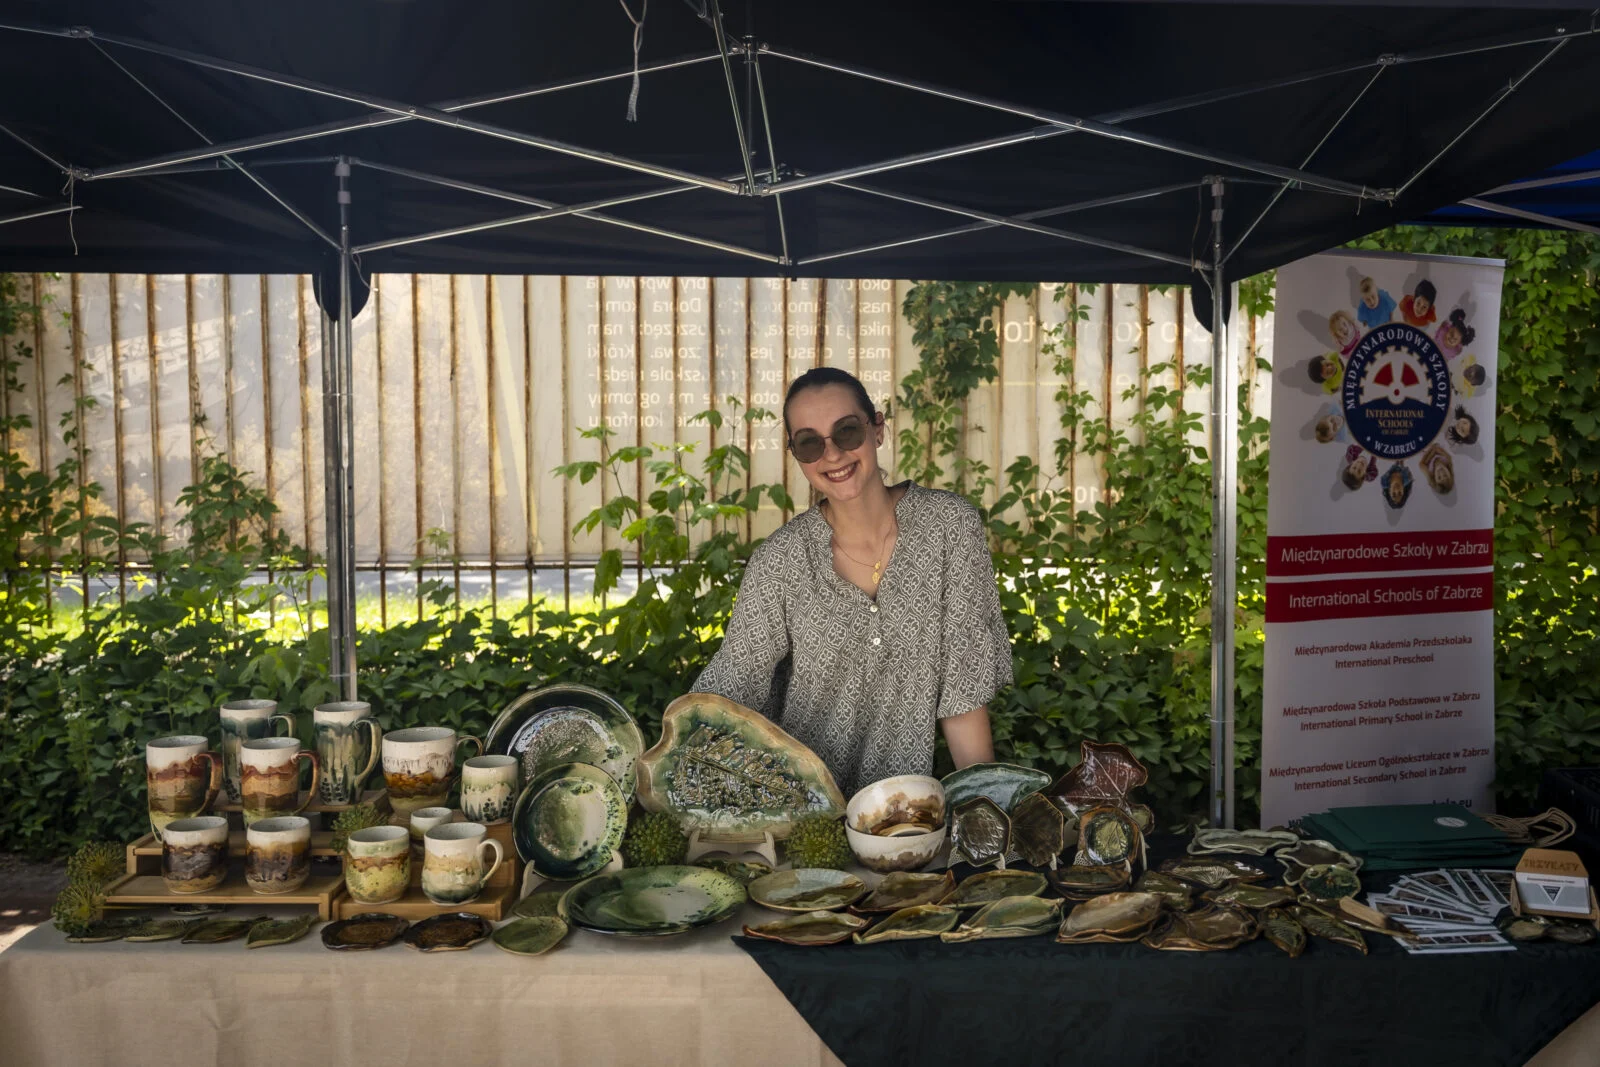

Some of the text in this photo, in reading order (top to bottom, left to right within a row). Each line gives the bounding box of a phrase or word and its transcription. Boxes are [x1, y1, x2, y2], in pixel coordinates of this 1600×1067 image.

[1346, 328, 1430, 410] MIĘDZYNARODOWE
[1365, 408, 1425, 419] INTERNATIONAL
[1377, 419, 1414, 428] SCHOOLS
[1374, 440, 1417, 454] W ZABRZU
[1281, 541, 1489, 565] Międzynarodowe Szkoły w Zabrzu
[1289, 584, 1483, 609] International Schools of Zabrze
[1294, 635, 1472, 657] Międzynarodowa Akademia Przedszkolaka
[1335, 653, 1434, 669] International Preschool
[1282, 691, 1481, 718] Międzynarodowa Szkoła Podstawowa w Zabrzu
[1300, 708, 1463, 732] International Primary School in Zabrze
[1269, 761, 1344, 778] Międzynarodowe
[1345, 757, 1377, 770] Liceum
[1452, 751, 1460, 759] w
[1462, 746, 1490, 759] Zabrzu
[1294, 764, 1467, 791] International Secondary School in Zabrze
